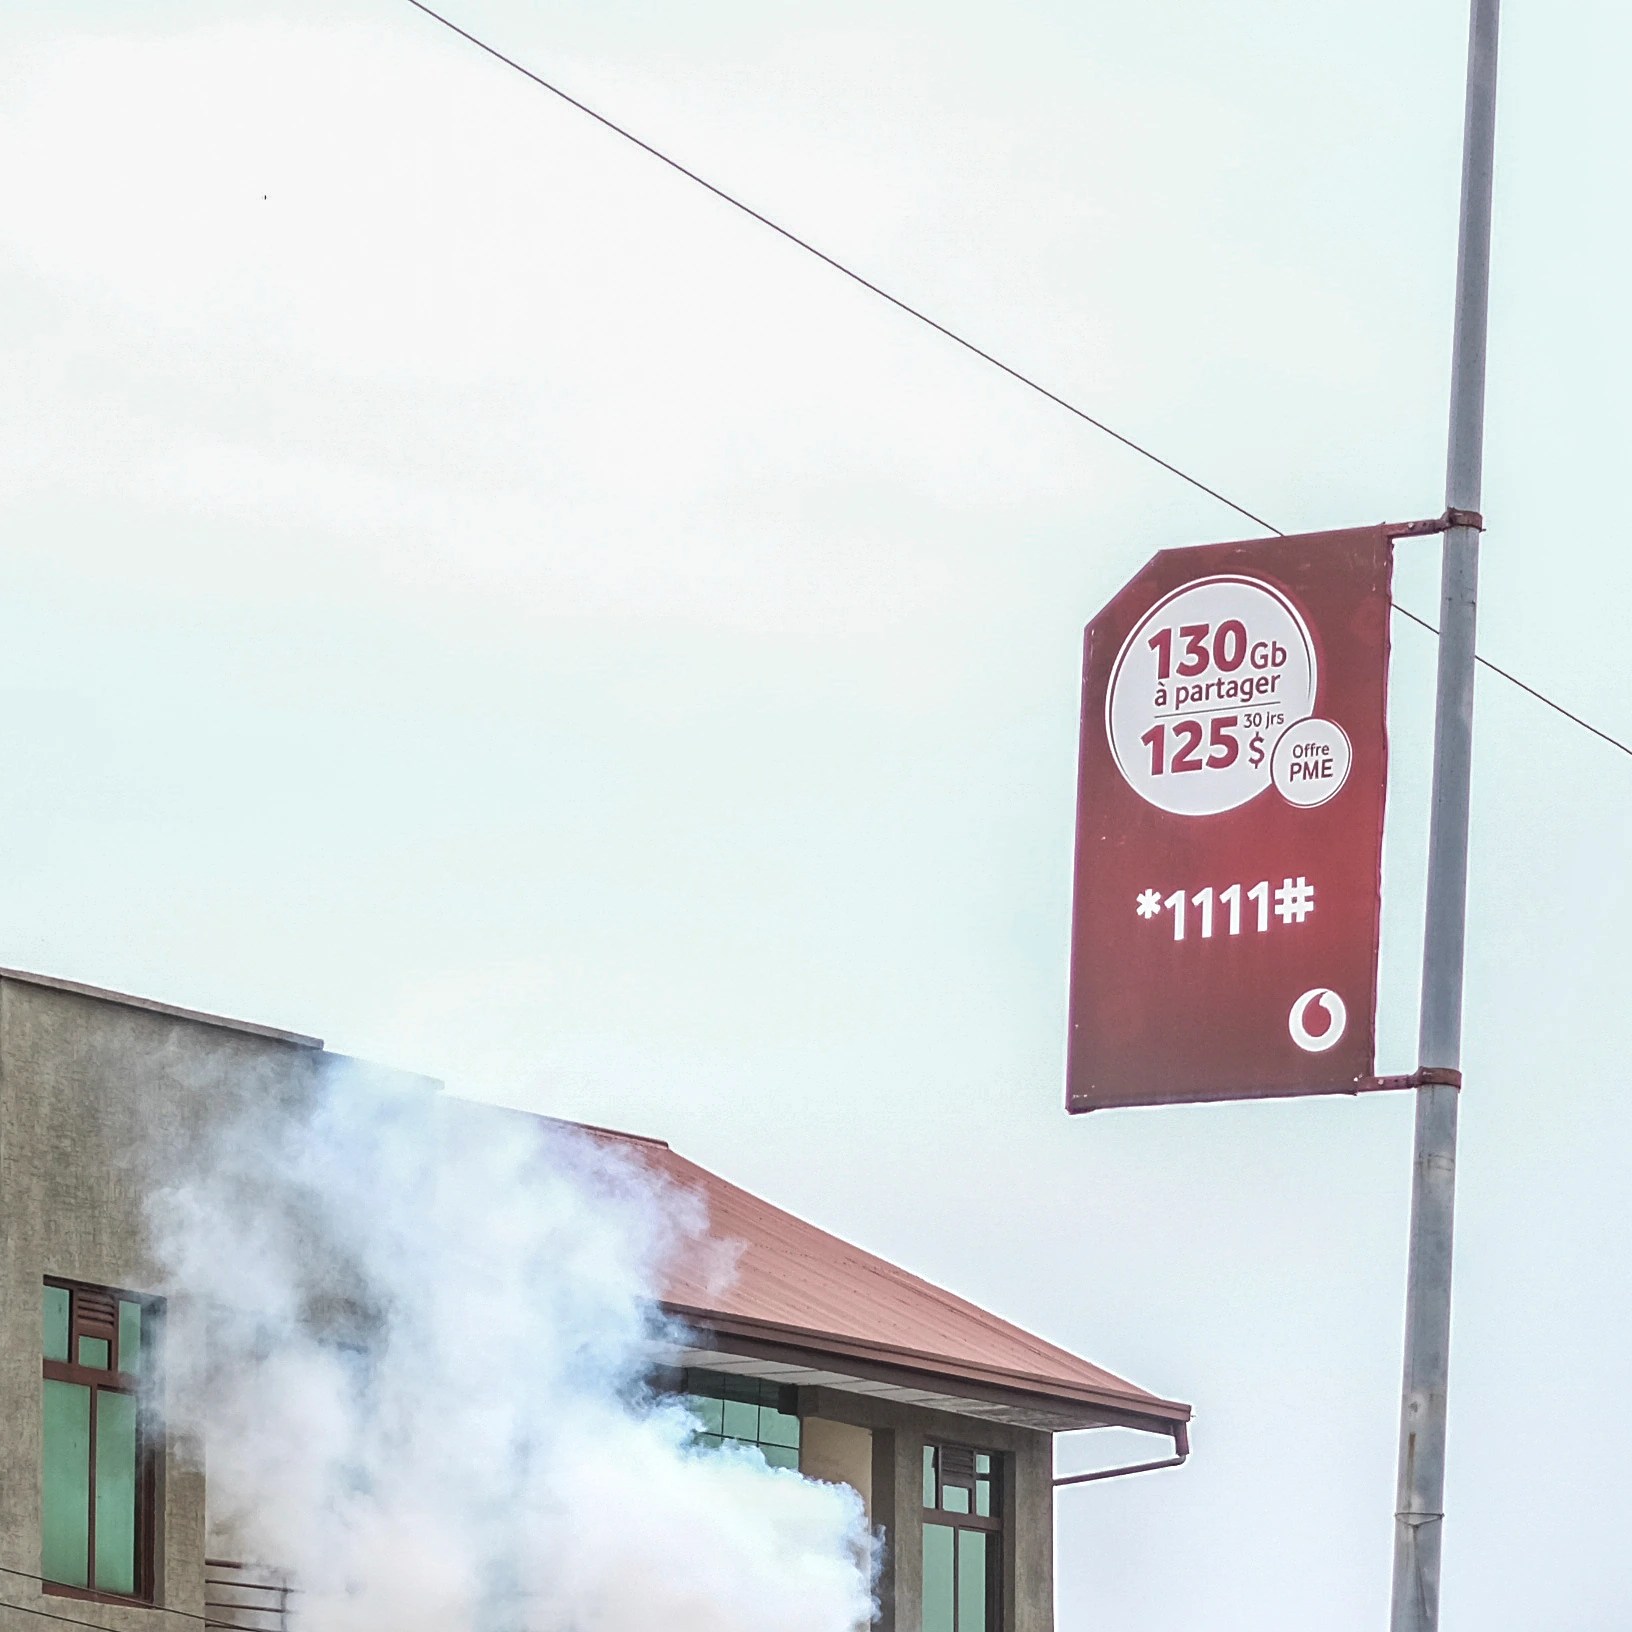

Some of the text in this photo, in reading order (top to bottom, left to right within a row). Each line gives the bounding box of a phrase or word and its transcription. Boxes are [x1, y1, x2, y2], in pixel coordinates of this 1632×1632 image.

[1154, 674, 1281, 710] à partager
[1243, 710, 1285, 729] 30 jrs
[1141, 715, 1239, 776] 125
[1292, 743, 1330, 759] Offre
[1289, 758, 1334, 782] PME
